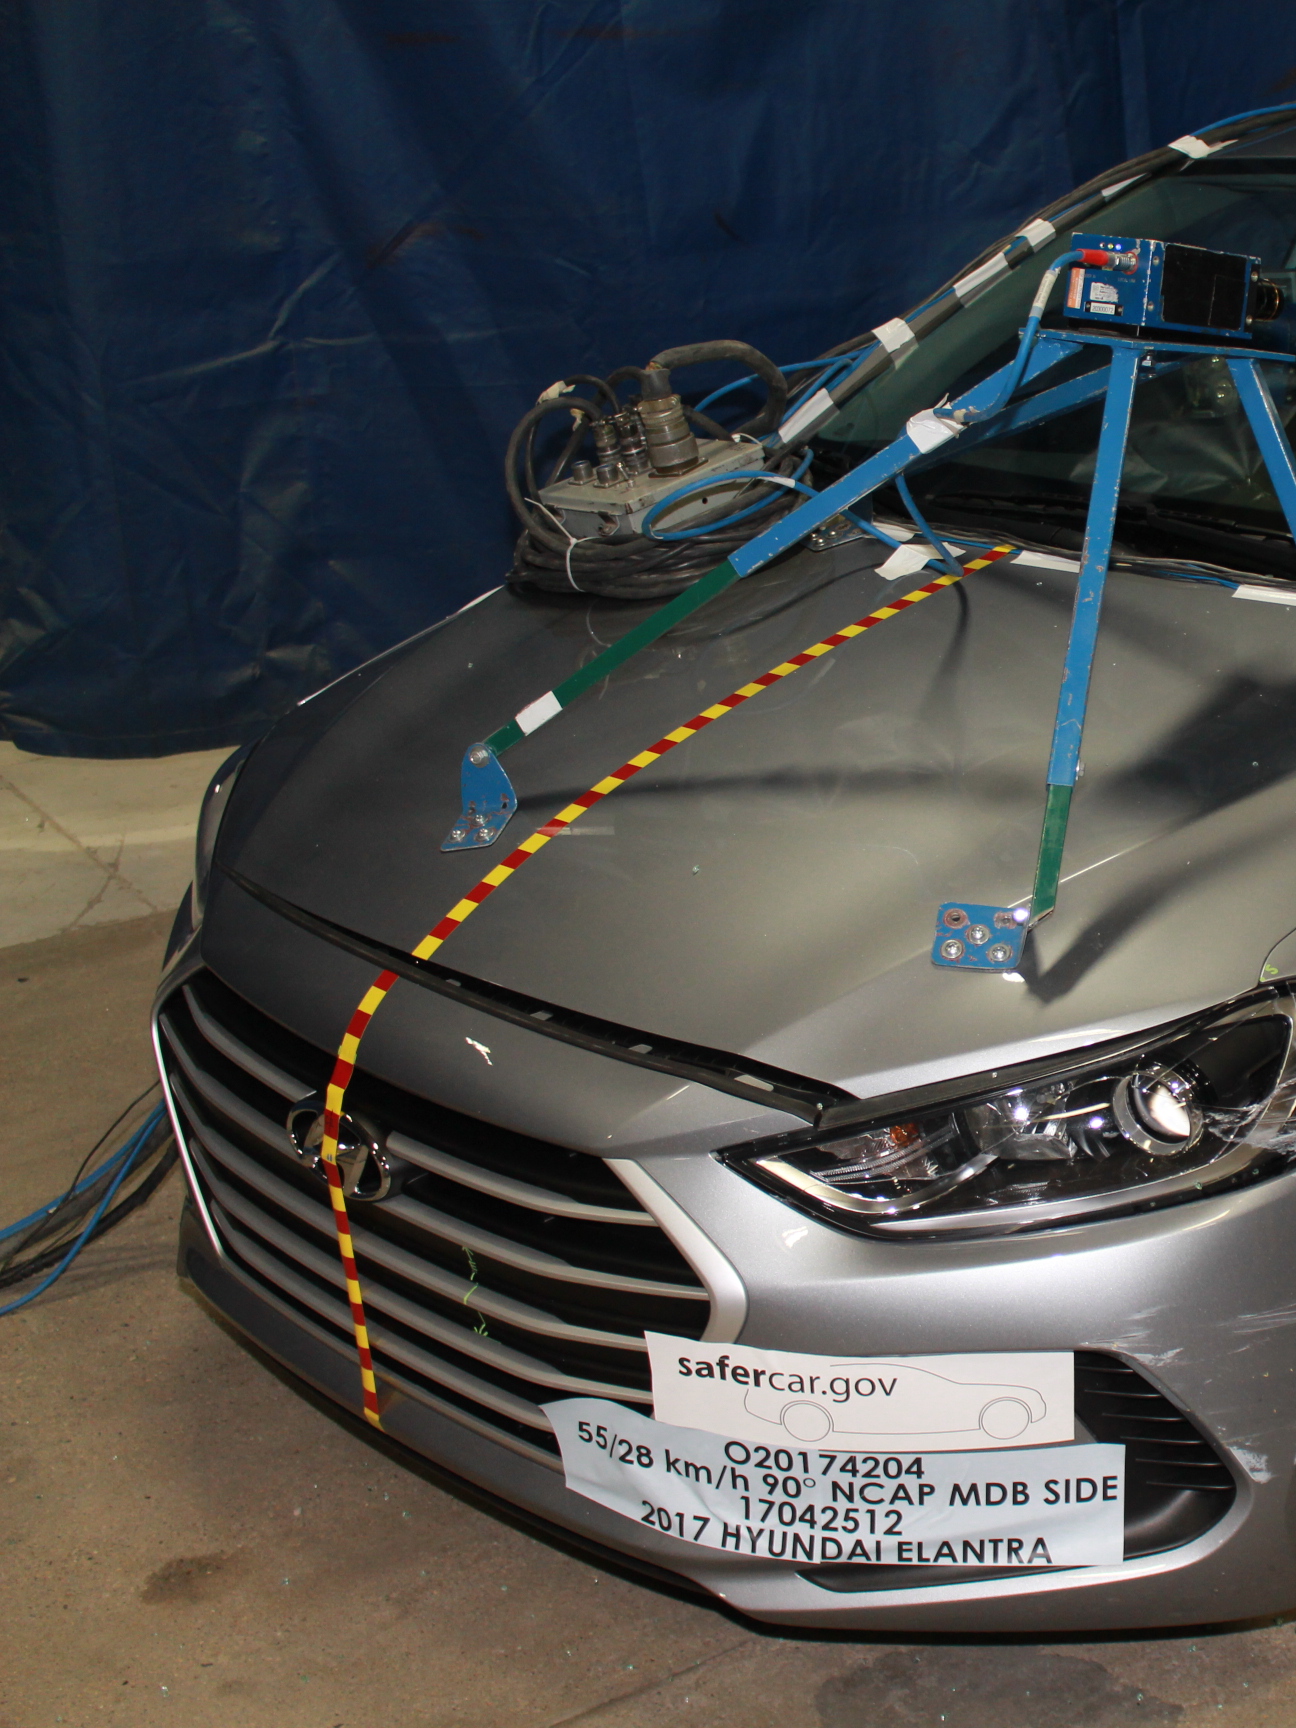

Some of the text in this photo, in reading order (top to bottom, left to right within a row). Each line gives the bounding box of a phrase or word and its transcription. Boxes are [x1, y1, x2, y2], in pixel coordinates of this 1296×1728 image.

[677, 1355, 898, 1402] safercar.gov
[578, 1421, 1118, 1506] 55/28 km/h 90° NCAP MDB SIDE
[641, 1500, 1053, 1565] 2017 HYUNDAI ELANTRA
[740, 1495, 903, 1536] 17042512
